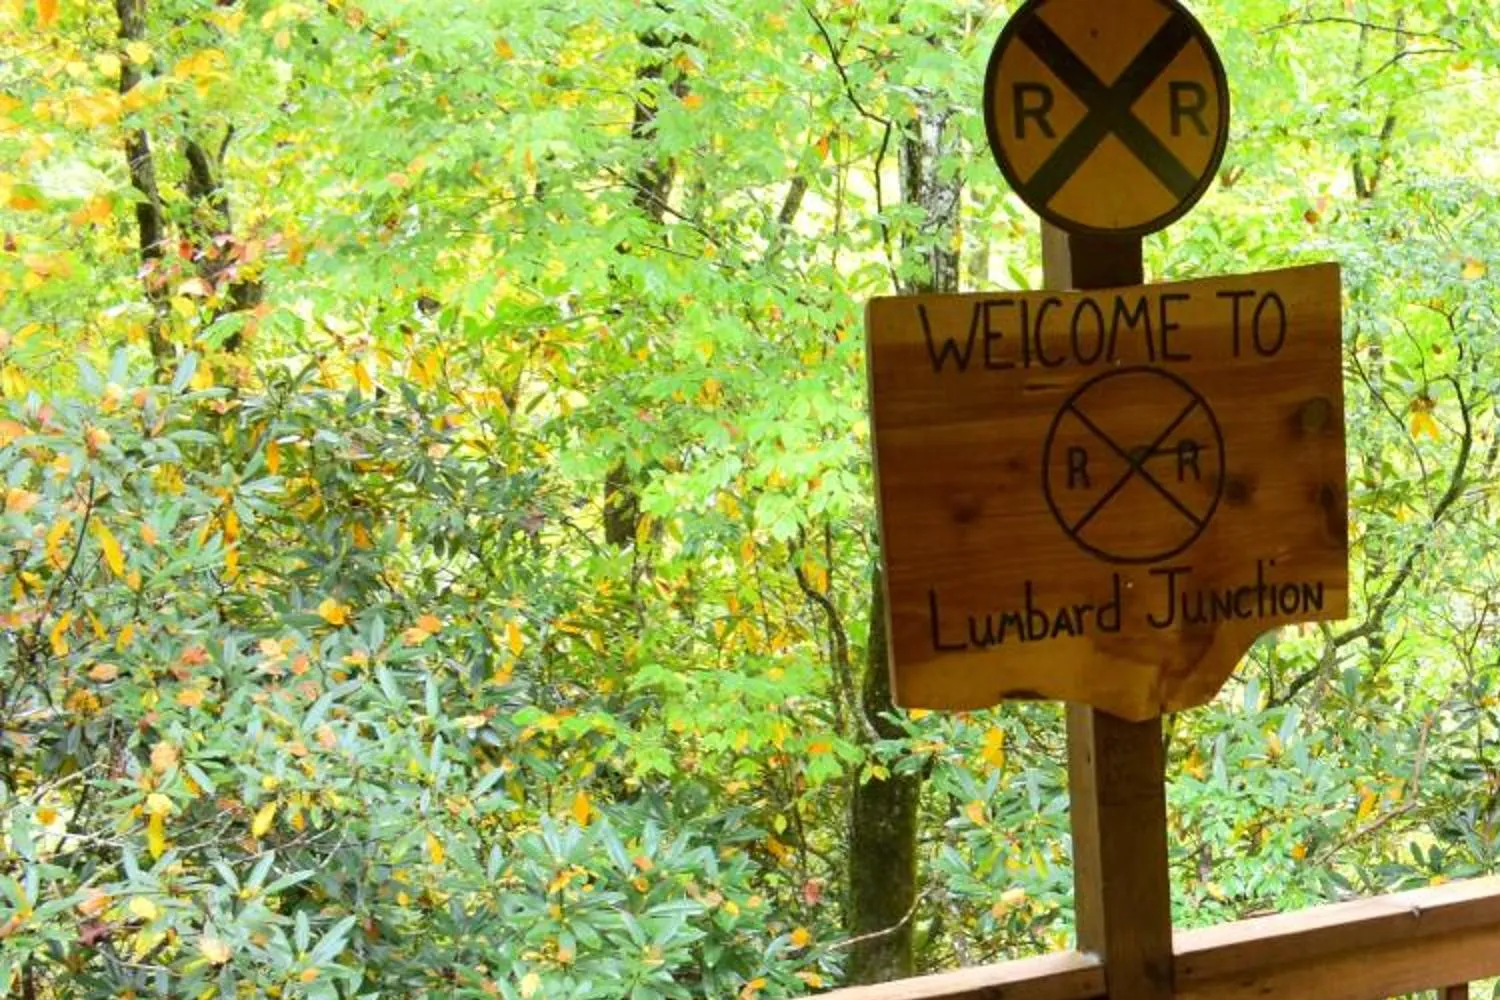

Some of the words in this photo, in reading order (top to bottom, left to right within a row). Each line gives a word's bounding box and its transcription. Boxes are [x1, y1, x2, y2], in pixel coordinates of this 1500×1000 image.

[1013, 82, 1056, 139] R
[1168, 80, 1209, 137] R
[1215, 289, 1287, 358] TO
[1067, 445, 1092, 489] R
